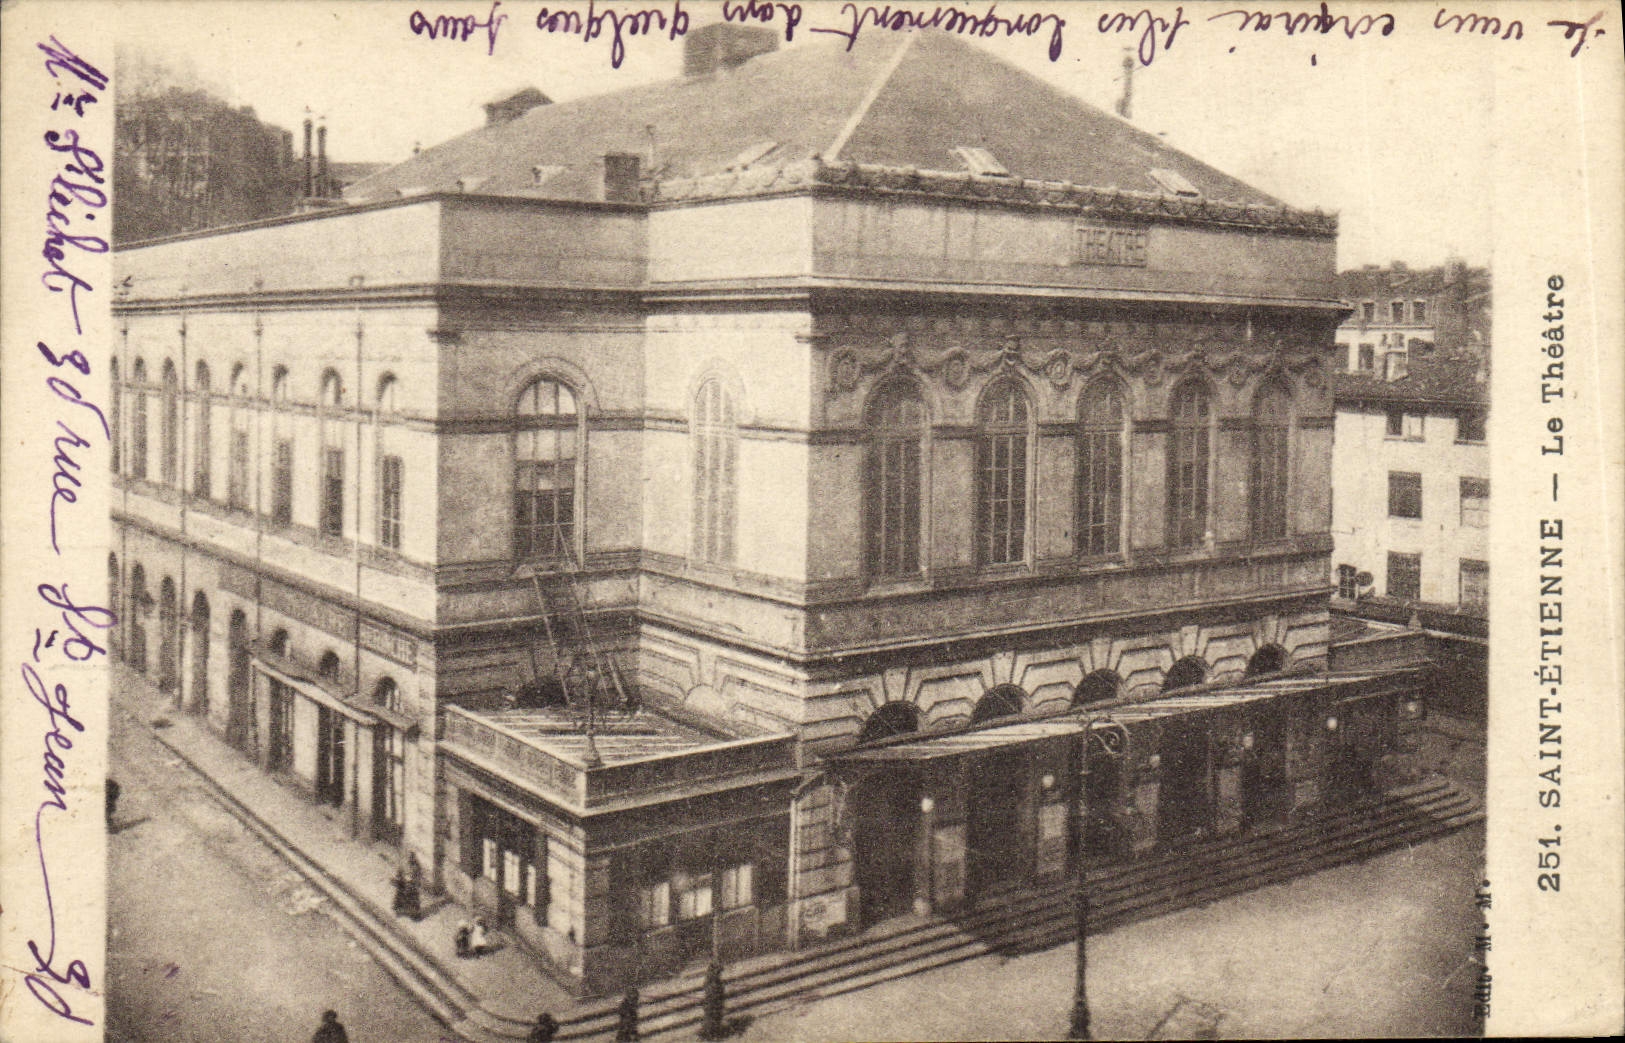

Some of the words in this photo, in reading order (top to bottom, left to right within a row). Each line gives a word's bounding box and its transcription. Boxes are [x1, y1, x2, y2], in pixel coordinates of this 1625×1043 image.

[409, 2, 508, 57] jours
[536, 0, 690, 70] quelques
[722, 0, 802, 42] dans
[1097, 6, 1190, 67] plus
[1433, 8, 1524, 41] vous
[50, 421, 91, 553] rue
